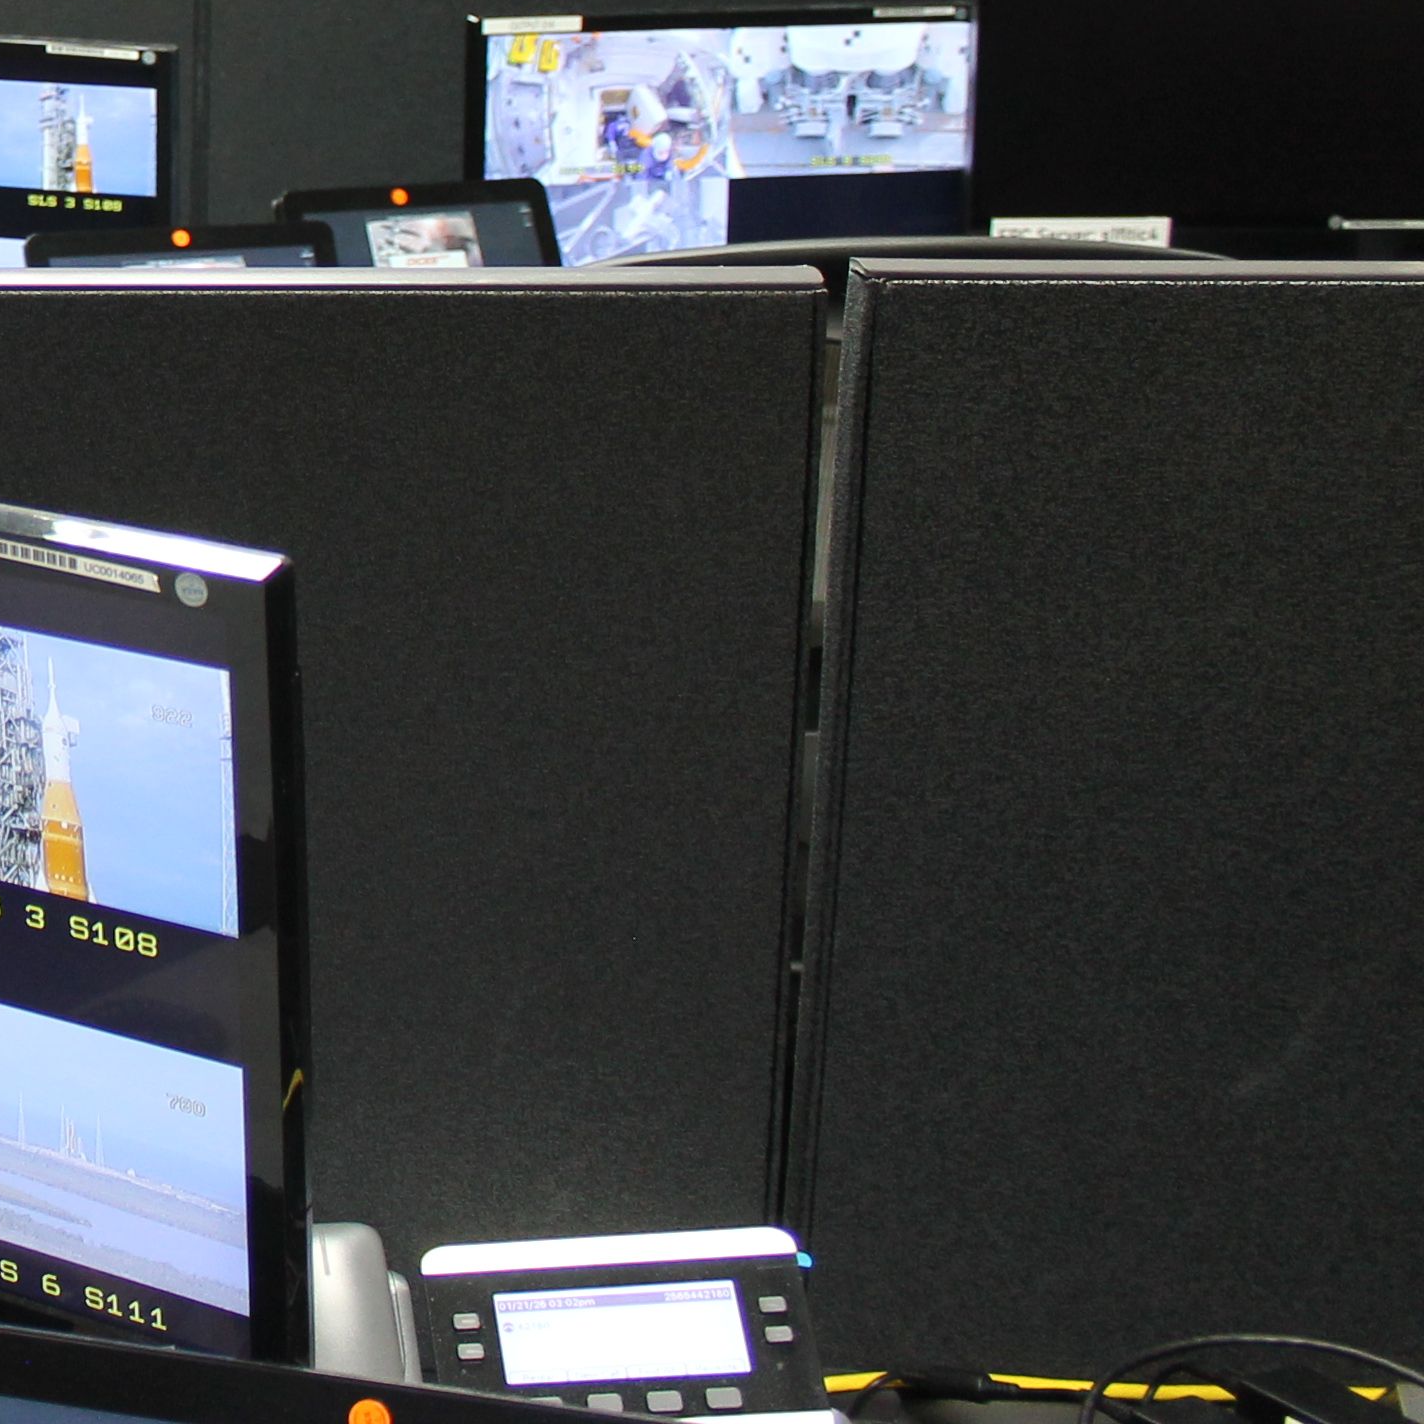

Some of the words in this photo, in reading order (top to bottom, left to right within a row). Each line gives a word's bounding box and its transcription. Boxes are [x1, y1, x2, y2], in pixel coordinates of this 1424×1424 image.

[27, 194, 57, 207] SLS
[64, 197, 76, 209] 3
[25, 904, 46, 930] 3
[69, 916, 159, 959] S108
[41, 1274, 61, 1297] 6
[84, 1286, 168, 1332] S111
